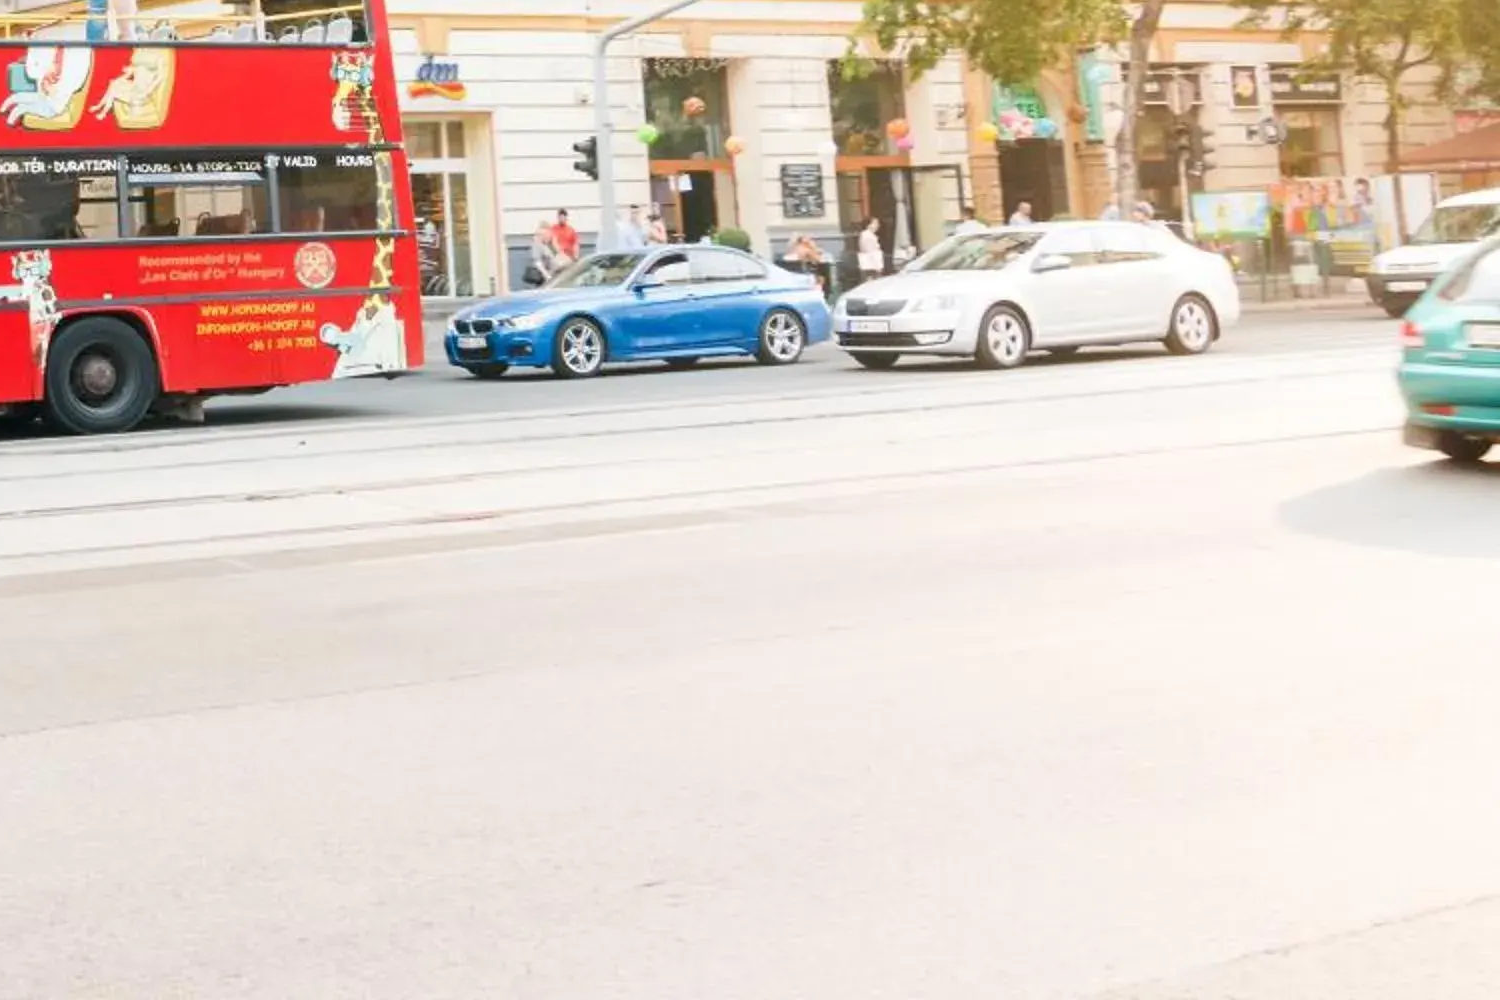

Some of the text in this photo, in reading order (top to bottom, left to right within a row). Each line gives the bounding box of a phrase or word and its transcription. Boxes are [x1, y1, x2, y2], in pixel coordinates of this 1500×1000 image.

[416, 54, 458, 82] dm
[283, 155, 317, 167] VALID
[336, 155, 372, 167] HOURS
[140, 254, 223, 267] Recommended
[228, 251, 241, 265] by
